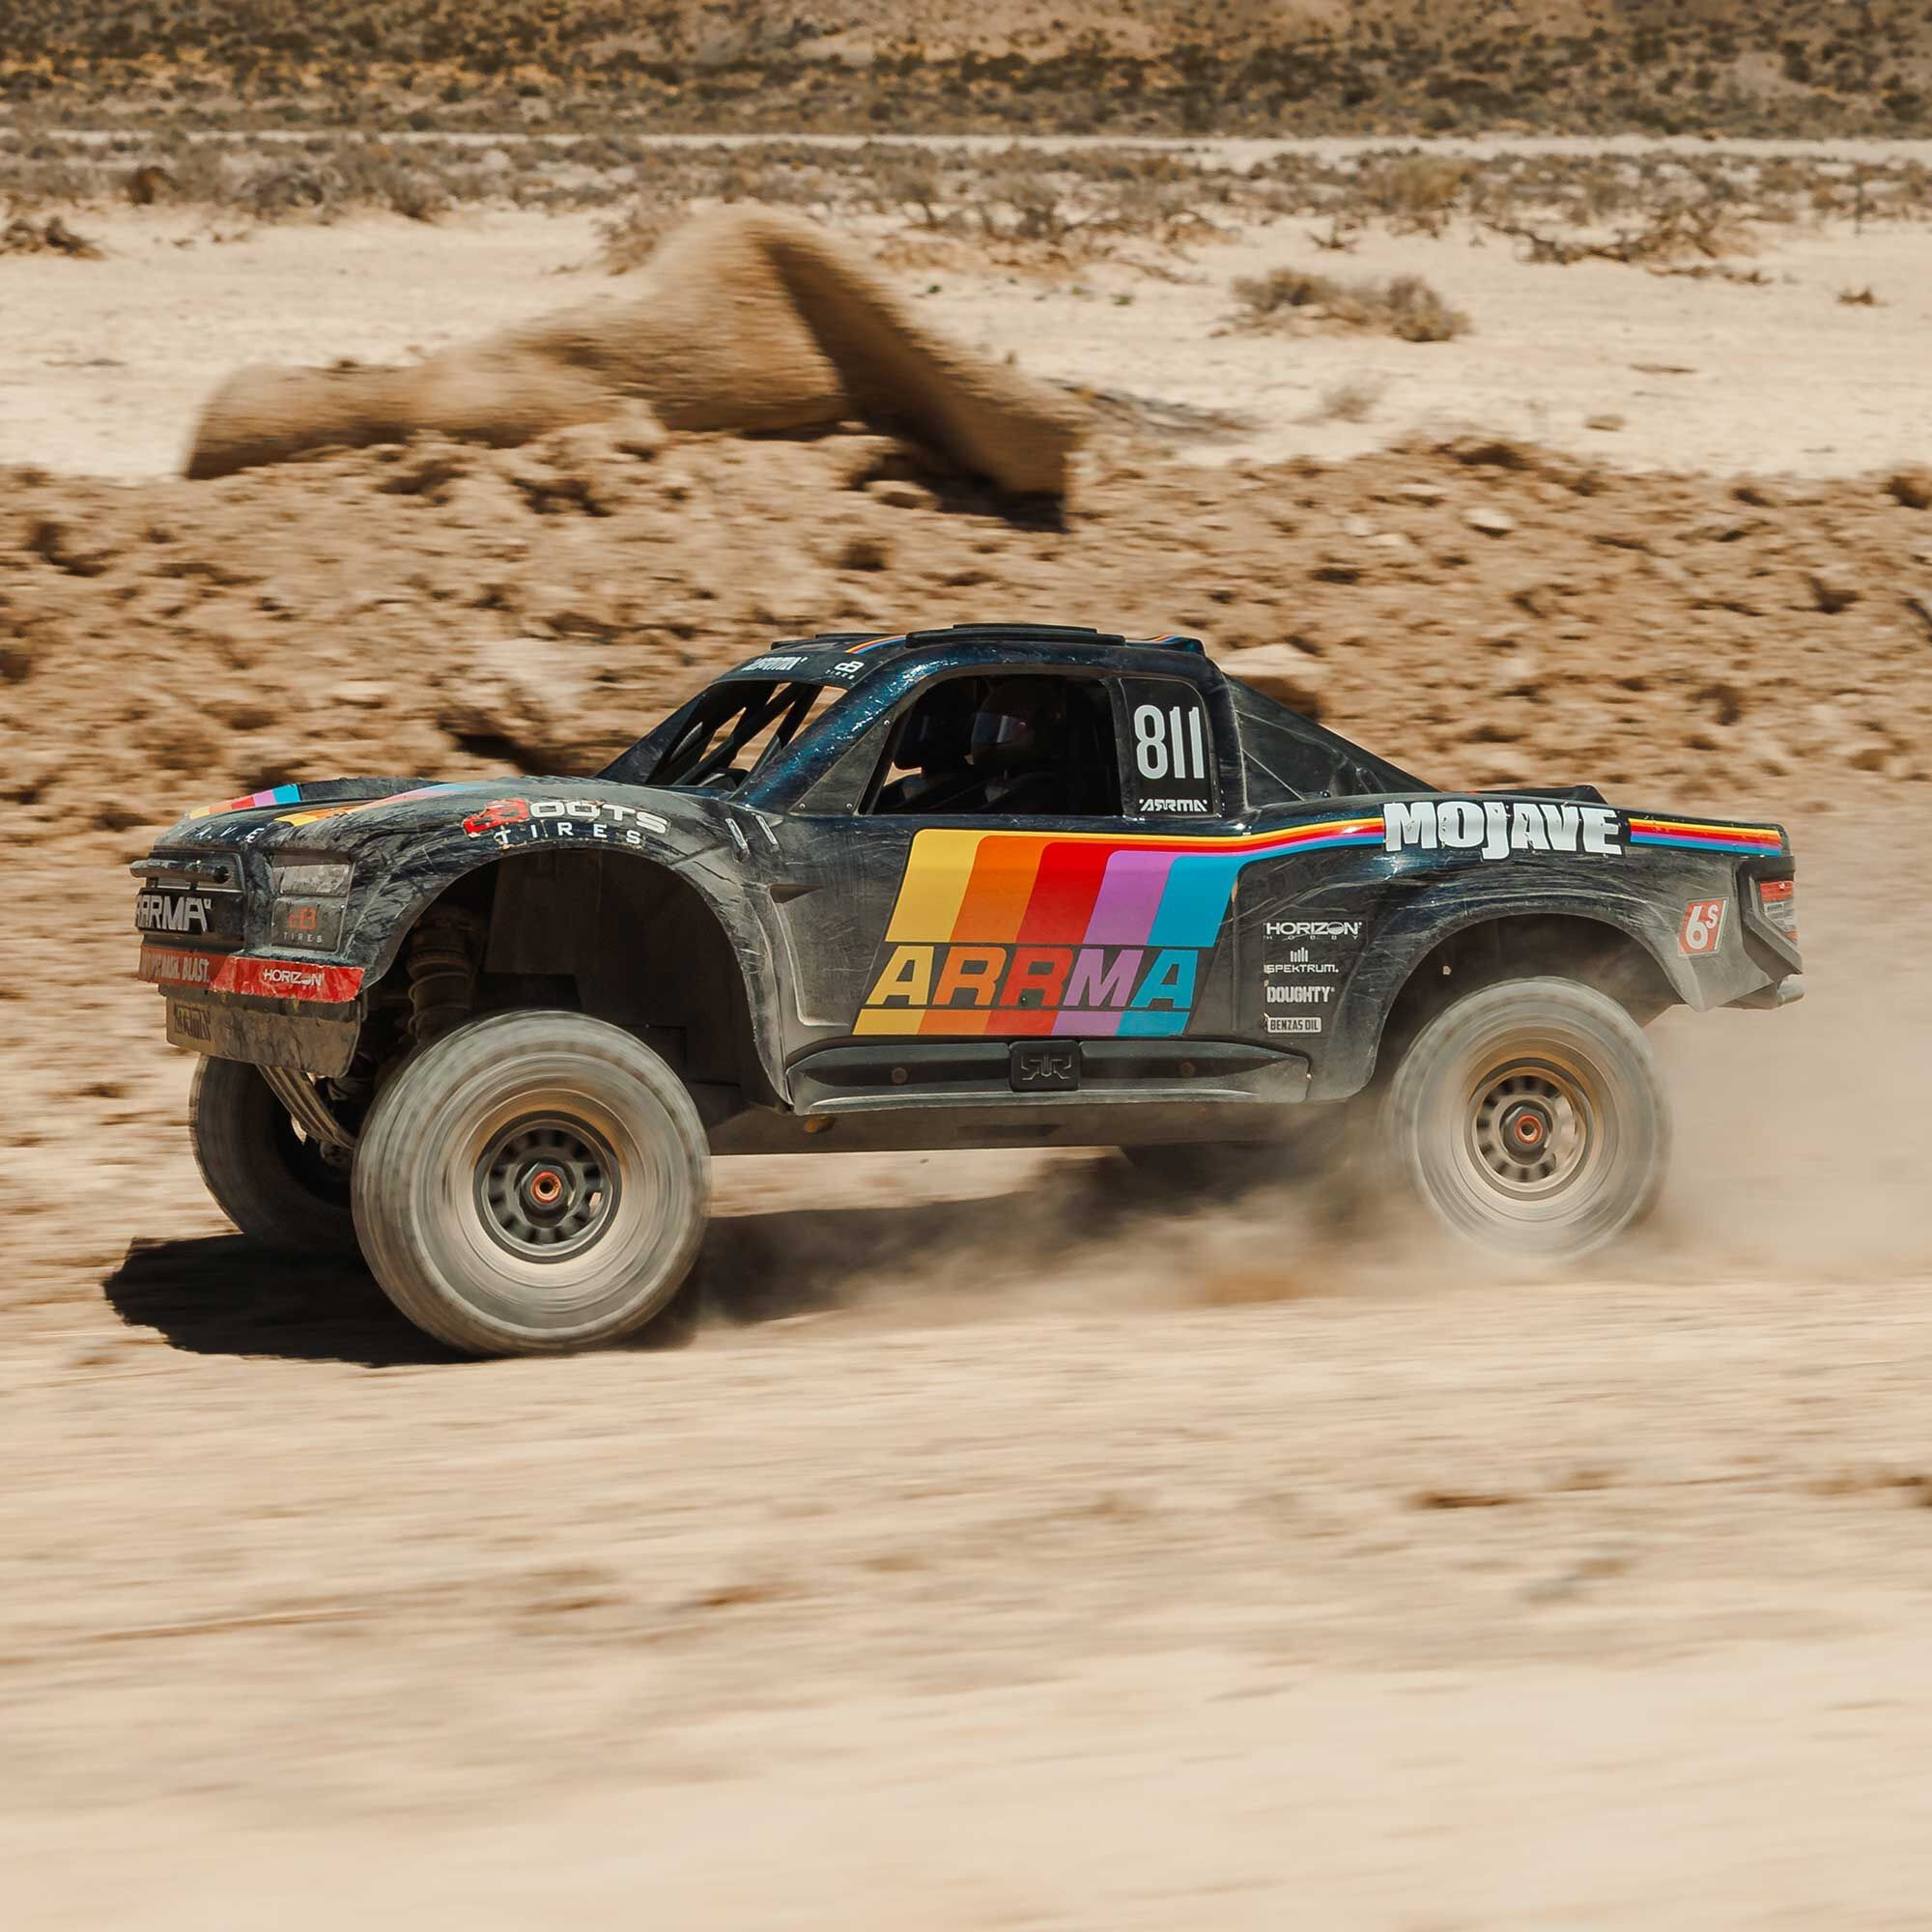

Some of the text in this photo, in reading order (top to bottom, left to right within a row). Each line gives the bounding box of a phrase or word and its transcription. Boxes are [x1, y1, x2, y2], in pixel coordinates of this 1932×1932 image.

[1134, 704, 1205, 780] 811
[495, 820, 642, 848] TIRES
[1383, 801, 1623, 861] MOJAVE
[284, 931, 323, 943] TIRES
[1265, 921, 1359, 936] HORIZON
[865, 945, 1200, 1009] ARRMA
[1266, 986, 1331, 1004] DOUGHTY
[1304, 1019, 1320, 1031] OIL
